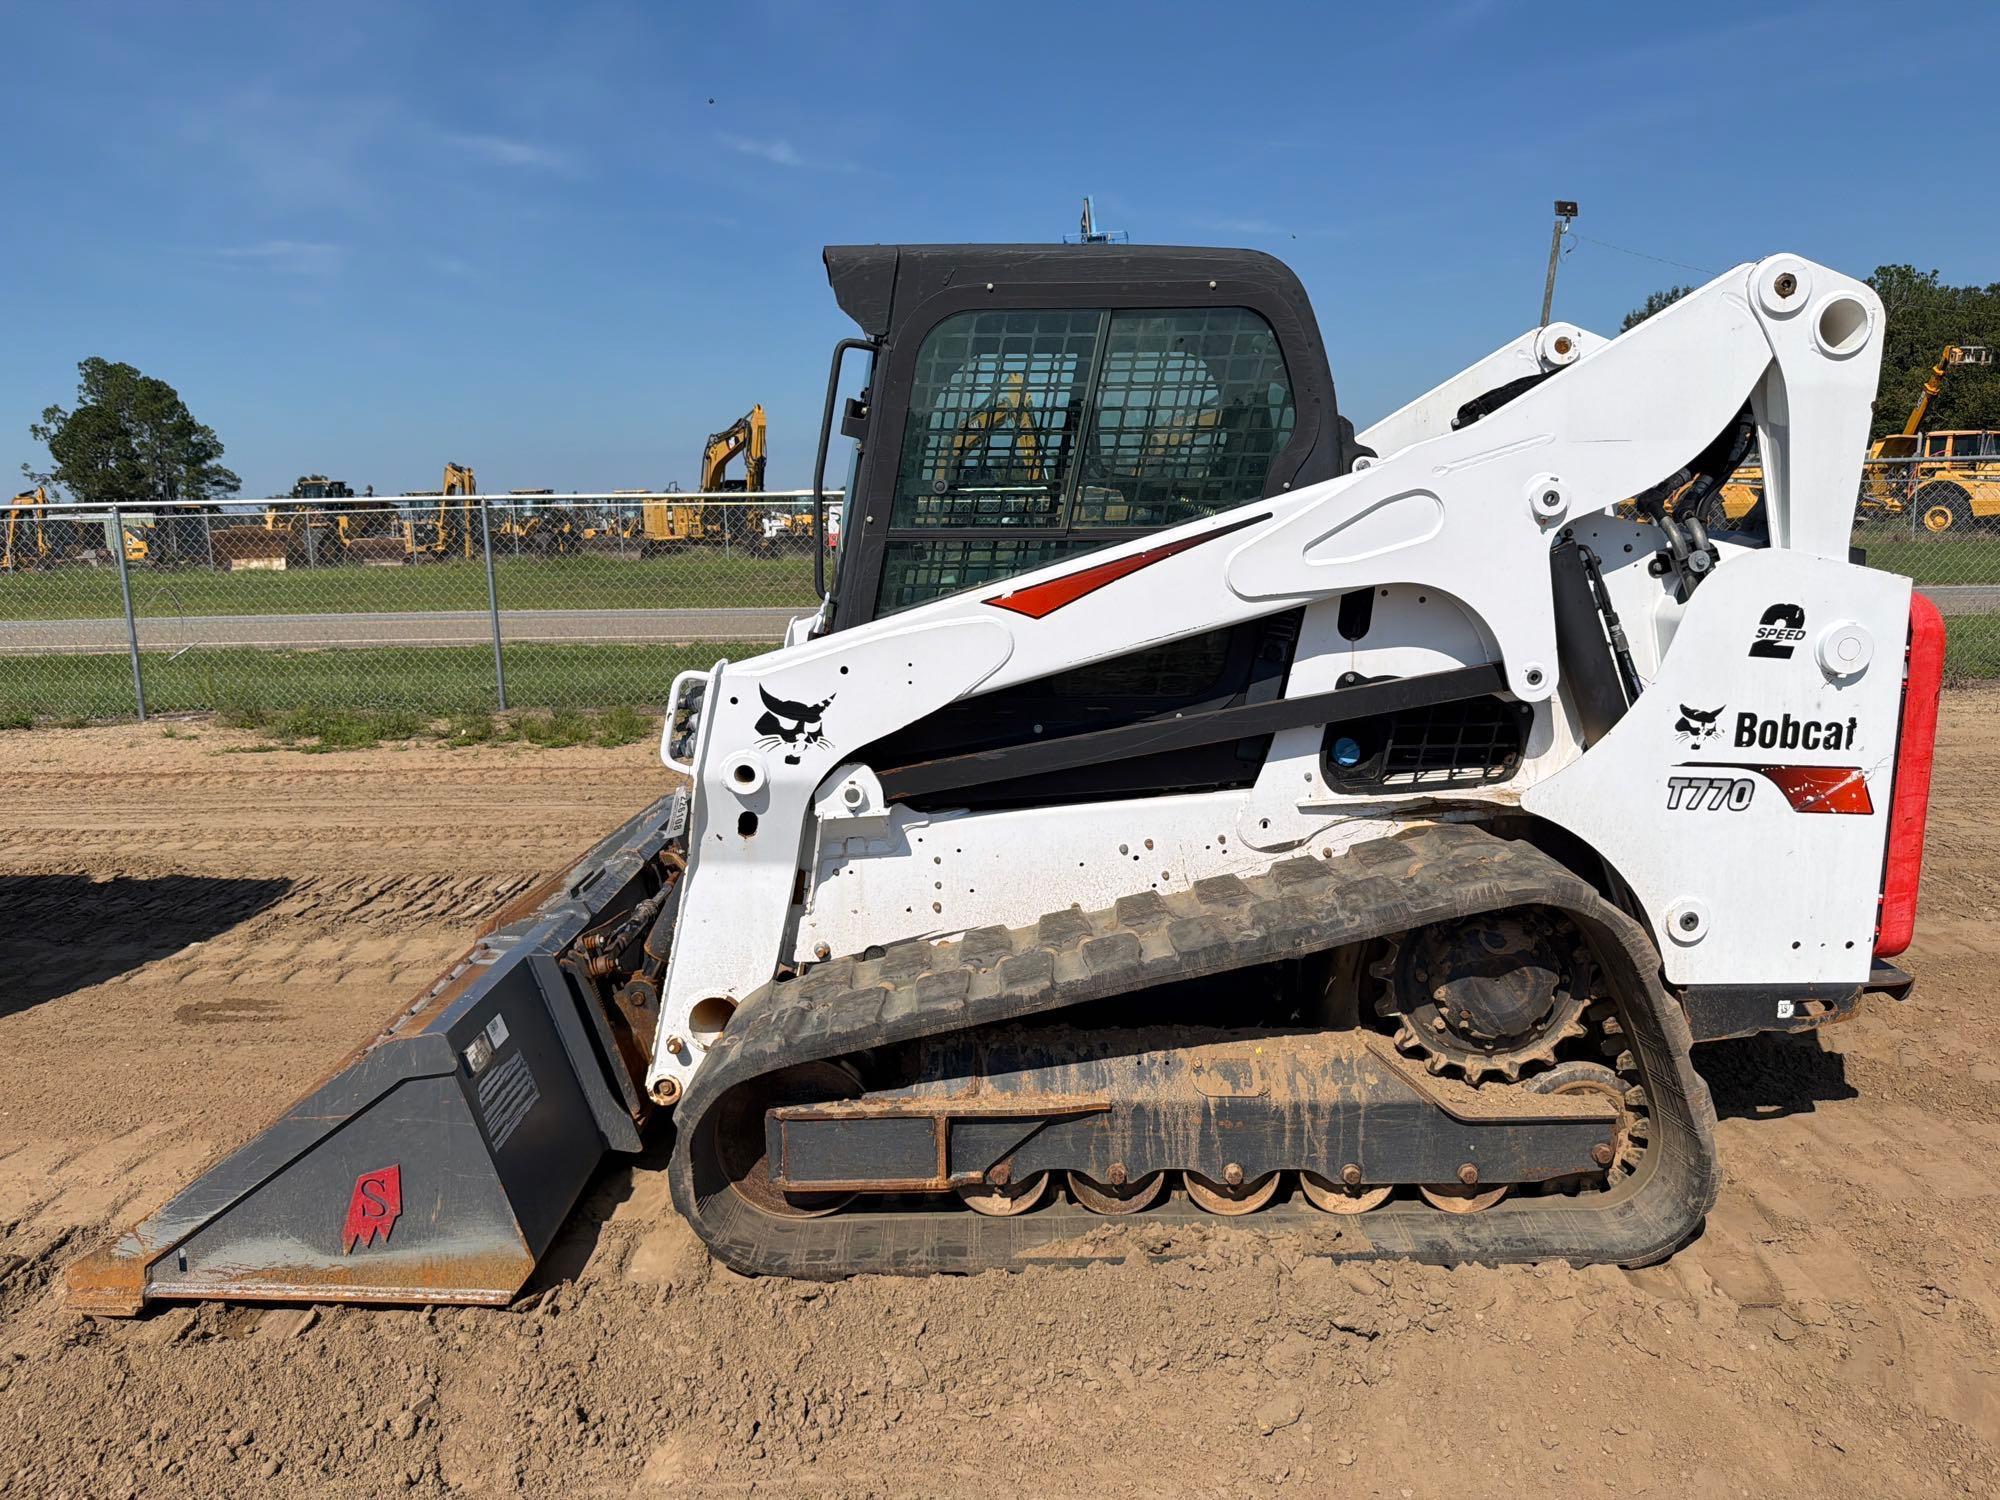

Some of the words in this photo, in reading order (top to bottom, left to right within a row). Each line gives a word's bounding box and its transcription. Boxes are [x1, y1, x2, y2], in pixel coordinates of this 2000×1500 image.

[1747, 603, 1806, 660] 2
[1755, 627, 1807, 641] SPEED
[1734, 712, 1858, 751] Bobcat
[1667, 776, 1755, 812] T770
[361, 1179, 389, 1219] S
